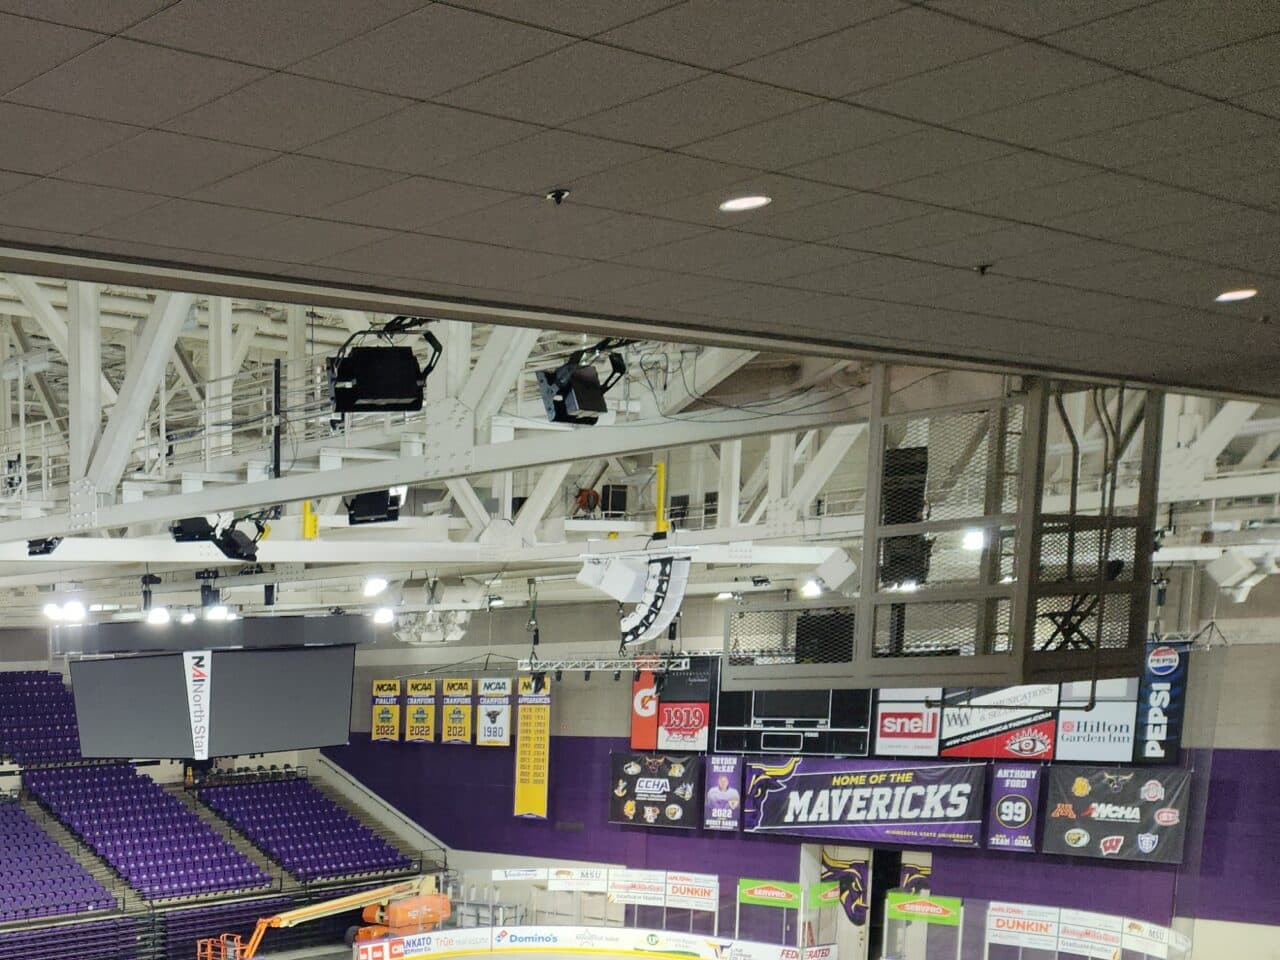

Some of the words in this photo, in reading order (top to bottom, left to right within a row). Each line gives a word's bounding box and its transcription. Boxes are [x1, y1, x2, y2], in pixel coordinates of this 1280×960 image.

[376, 683, 396, 692] NCAA
[483, 682, 506, 690] NCAA
[663, 706, 704, 729] 1919
[882, 712, 933, 733] snell
[1144, 683, 1171, 758] PEPSI
[376, 725, 395, 735] 2022
[410, 726, 430, 736] 2022
[448, 726, 465, 736] 2021
[484, 727, 503, 737] 1980
[1076, 721, 1129, 733] Hilton
[1062, 734, 1105, 742] Garden
[1109, 734, 1130, 743] Inn
[832, 775, 866, 785] HOME
[870, 774, 886, 784] OF
[890, 772, 914, 783] THE
[997, 769, 1037, 779] ANTHONY
[636, 779, 670, 792] CCHA
[1005, 779, 1027, 788] FORD
[784, 784, 971, 822] MAVERICKS
[1000, 801, 1026, 822] 99
[1091, 803, 1140, 819] WCHA
[671, 885, 712, 897] DUNKIN'
[996, 919, 1052, 933] DUNKIN'
[510, 934, 558, 943] Domino's
[1149, 930, 1164, 940] MSU
